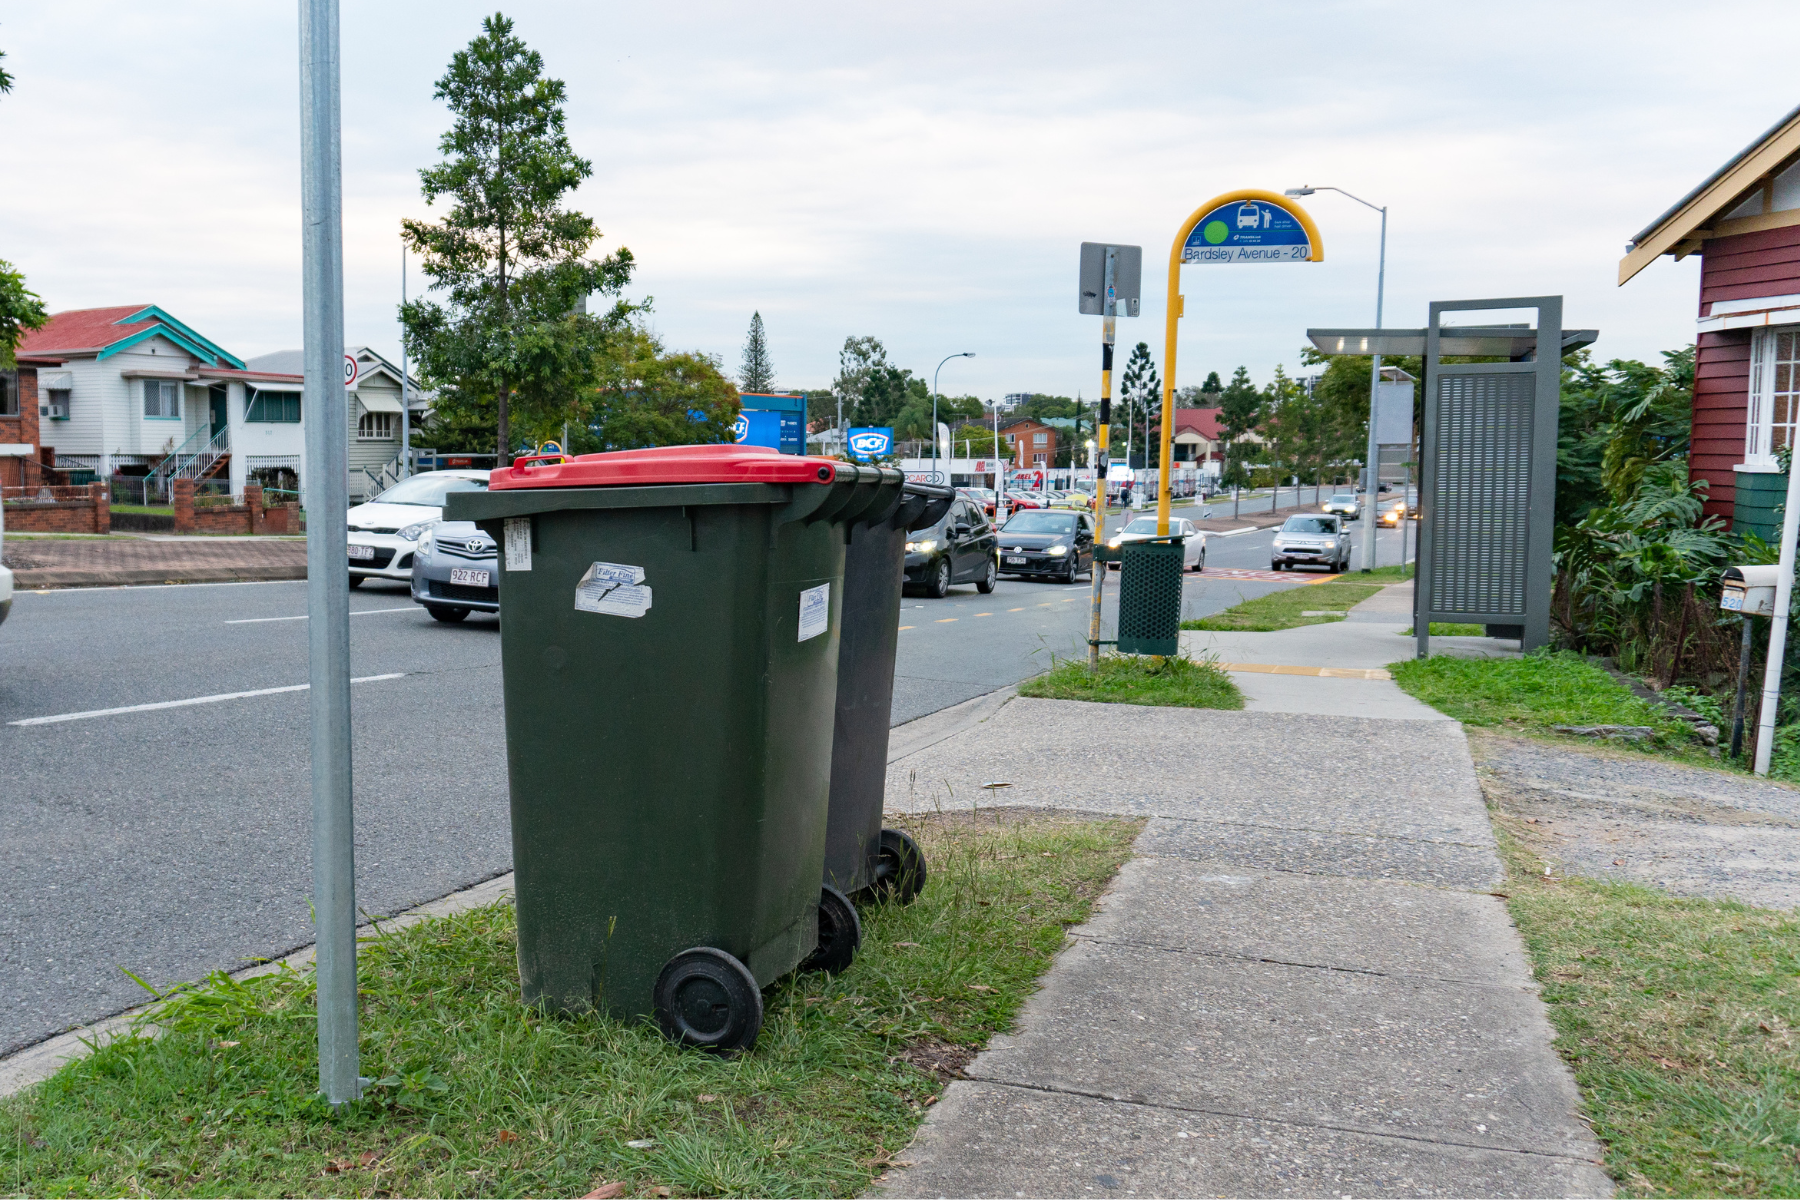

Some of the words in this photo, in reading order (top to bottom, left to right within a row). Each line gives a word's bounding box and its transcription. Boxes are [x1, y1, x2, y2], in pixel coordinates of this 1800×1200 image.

[1184, 248, 1234, 262] Bardsley
[1238, 247, 1280, 259] Avenue
[1291, 246, 1308, 259] 20
[345, 363, 353, 377] 0
[452, 569, 468, 581] 922
[470, 571, 488, 583] RCF
[598, 567, 617, 577] Filter
[1721, 597, 1743, 610] 520
